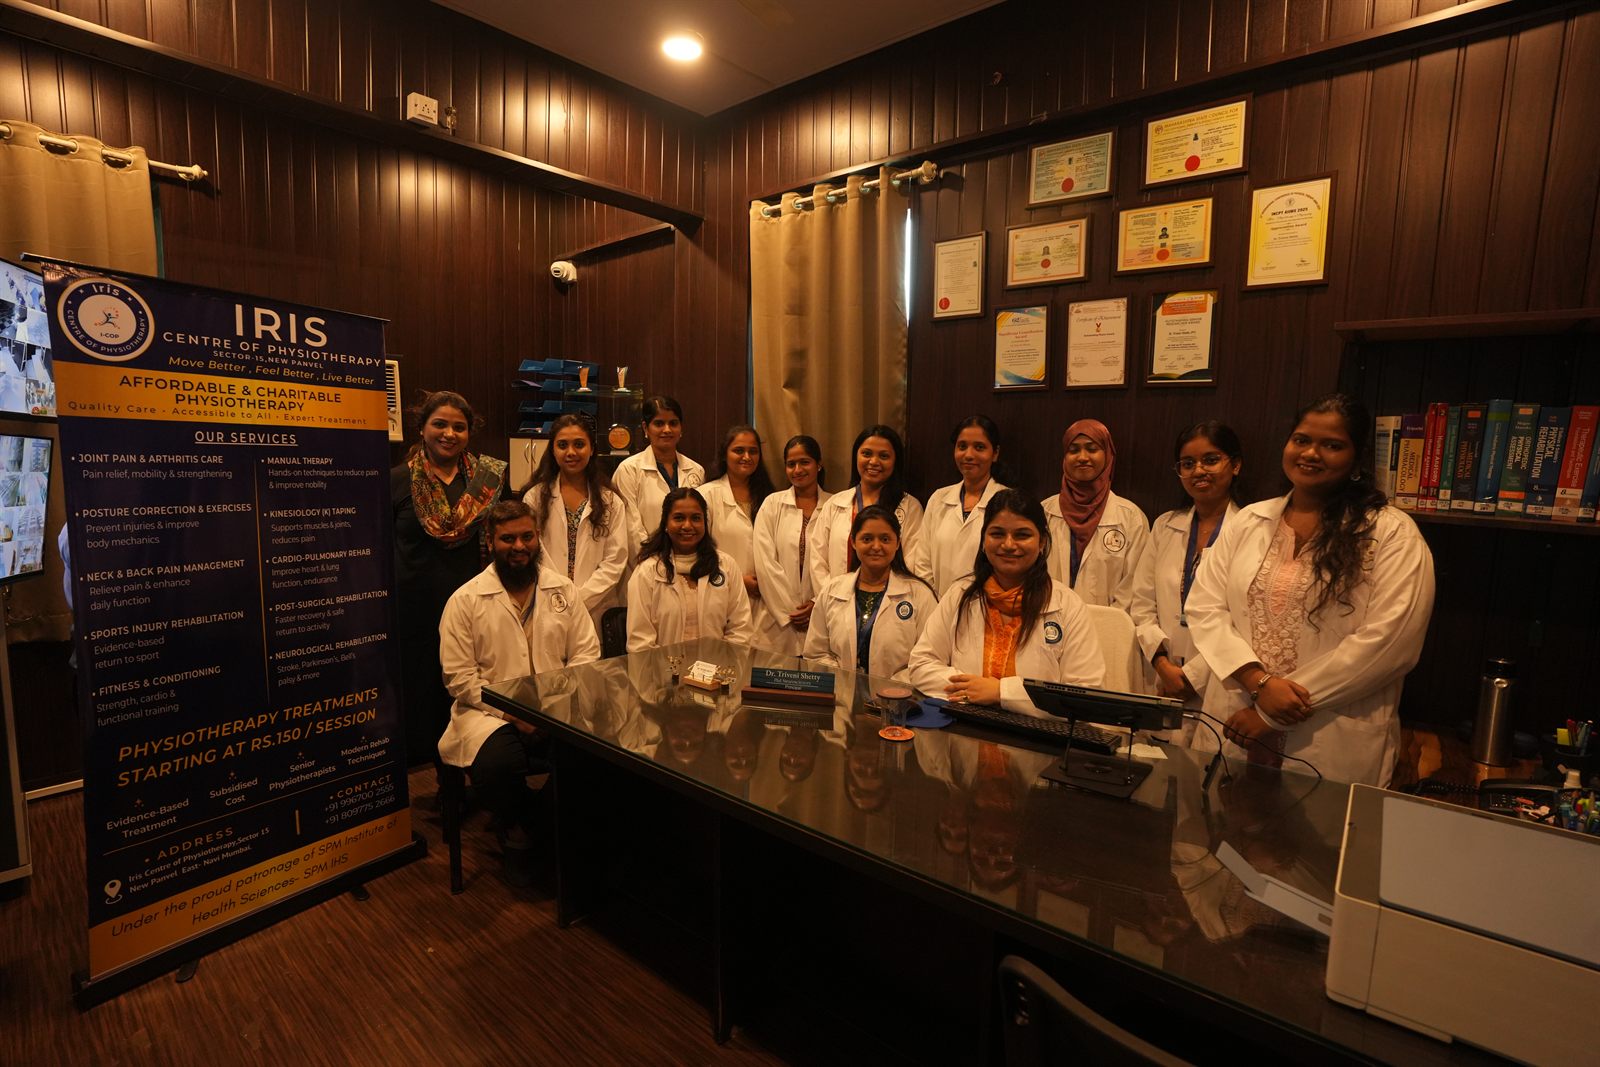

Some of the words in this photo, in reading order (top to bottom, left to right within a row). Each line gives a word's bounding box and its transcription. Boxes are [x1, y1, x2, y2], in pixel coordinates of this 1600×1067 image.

[92, 284, 120, 296] Iris
[235, 303, 328, 347] IRIS
[163, 331, 231, 349] CENTRE
[240, 341, 260, 352] OF
[268, 344, 380, 368] PHYSIOTHERAPY
[168, 356, 204, 368] Move
[209, 360, 246, 373] Better
[256, 366, 280, 376] Feel
[283, 368, 314, 380] Better
[322, 372, 343, 383] Live
[346, 374, 375, 386] Better
[292, 360, 324, 369] PANVEL
[120, 375, 237, 395] AFFORDABLE
[242, 384, 252, 395] &
[257, 386, 342, 404] CHARITABLE
[69, 400, 121, 414] Quality
[127, 404, 157, 415] Care
[172, 407, 237, 419] Accessible
[242, 412, 253, 420] to
[257, 412, 272, 420] All
[284, 414, 315, 424] Expert
[318, 416, 367, 425] Treatment
[176, 394, 305, 413] PHYSIOTHERAPY
[195, 431, 225, 443] OUR
[230, 432, 297, 445] SERVICES
[1435, 434, 1444, 455] Human
[1545, 426, 1558, 459] PHYSICAL
[1575, 427, 1590, 462] Therapeutic
[78, 454, 110, 464] JOINT
[113, 454, 137, 464] PAIN
[140, 455, 146, 463] &
[148, 455, 199, 464] ARTHRITIS
[200, 455, 224, 464] CARE
[1458, 440, 1467, 480] PHYSIOLOGY
[1506, 436, 1516, 470] ASSESSMENT
[1515, 436, 1524, 463] PHYSICAL
[1521, 436, 1532, 470] ORTHOPEDIC
[1531, 426, 1549, 479] REHABILITATION
[268, 457, 302, 465] MANUAL
[302, 457, 334, 465] THERAPY
[1400, 440, 1409, 492] PHARMACOLOGY
[1408, 451, 1416, 480] MEDICAL
[1432, 456, 1441, 483] Anatomy
[1464, 452, 1473, 480] MEDICAL
[83, 470, 103, 479] Pain
[105, 470, 130, 480] relief,
[132, 470, 167, 480] mobility
[177, 470, 233, 480] strengthening
[269, 469, 303, 477] Hands-on
[304, 469, 337, 478] techniques
[366, 470, 379, 478] pain
[1571, 462, 1582, 488] Exercise
[275, 482, 304, 491] improve
[82, 508, 130, 518] POSTURE
[132, 506, 196, 516] CORRECTION
[199, 505, 204, 513] &
[206, 504, 252, 513] EXERCISES
[270, 508, 321, 518] KINESIOLOGY
[332, 507, 357, 515] TAPING
[85, 524, 121, 533] Prevent
[123, 522, 156, 533] injuries
[157, 522, 164, 530] &
[165, 520, 200, 530] improve
[272, 522, 304, 532] Supports
[304, 522, 330, 530] muscles
[87, 539, 110, 549] body
[111, 536, 161, 546] mechanics
[272, 536, 301, 545] reduces
[301, 535, 316, 545] pain
[272, 550, 348, 564] CARDIO-PULMONARY
[348, 548, 371, 557] REHAB
[87, 572, 114, 583] NECK
[117, 570, 123, 579] &
[126, 568, 154, 579] BACK
[157, 565, 181, 575] PAIN
[183, 560, 245, 573] MANAGEMENT
[272, 568, 301, 577] Improve
[302, 565, 320, 574] heart
[326, 563, 340, 572] lung
[90, 585, 121, 597] Relieve
[123, 583, 143, 594] pain
[144, 582, 151, 590] &
[152, 579, 191, 589] enhance
[272, 579, 303, 590] function,
[304, 575, 338, 586] endurance
[90, 600, 111, 611] daily
[113, 596, 151, 608] function
[275, 599, 335, 611] POST-SURGICAL
[335, 590, 388, 604] REHABILITATION
[90, 626, 129, 641] SPORTS
[132, 621, 169, 634] INJURY
[171, 610, 245, 629] REHABILITATION
[275, 615, 297, 624] Faster
[297, 611, 326, 621] recovery
[276, 627, 301, 637] return
[307, 622, 331, 632] activity
[95, 635, 165, 655] Evidence-based
[275, 645, 334, 661] NEUROLOGICAL
[335, 633, 387, 649] REHABILITATION
[95, 657, 123, 669] return
[125, 655, 135, 664] to
[136, 651, 160, 663] sport
[99, 680, 140, 697] FITNESS
[143, 679, 150, 688] &
[152, 665, 221, 686] CONDITIONING
[278, 677, 296, 687] palsy
[302, 672, 320, 681] more
[778, 671, 800, 679] Triveni
[800, 673, 821, 682] Shetty
[97, 697, 139, 713] Strength,
[140, 691, 168, 704] cardio
[170, 689, 177, 698] &
[97, 709, 144, 728] functional
[144, 703, 180, 717] training
[118, 710, 279, 762] PHYSIOTHERAPY
[283, 687, 378, 721] TREATMENTS
[117, 749, 217, 788] STARTING
[222, 741, 247, 760] AT
[251, 727, 301, 752] RS.150
[315, 707, 376, 735] SESSION
[340, 744, 369, 757] Modern
[370, 737, 390, 748] Rehab
[290, 760, 316, 773] Senior
[347, 750, 386, 766] Techniques
[209, 778, 259, 799] Subsidised
[269, 765, 337, 791] Physiotherapists
[337, 774, 392, 798] CONTACT
[225, 794, 246, 807] Cost
[340, 790, 374, 808] 996700
[106, 798, 190, 830] Evidence-Based
[341, 803, 374, 820] 809775
[122, 816, 177, 838] Treatment
[157, 828, 233, 860] ADDRESS
[144, 863, 171, 877] Centre
[112, 911, 159, 937] Under
[164, 900, 187, 916] the
[192, 880, 232, 909] proud
[236, 858, 300, 891] patronage
[304, 848, 316, 862] of
[318, 840, 342, 856] SPM
[345, 825, 384, 846] Institute
[130, 881, 150, 893] New
[150, 871, 178, 886] Panvel
[193, 899, 236, 925] Health
[304, 862, 328, 880] SPM
[331, 853, 348, 869] IHS
